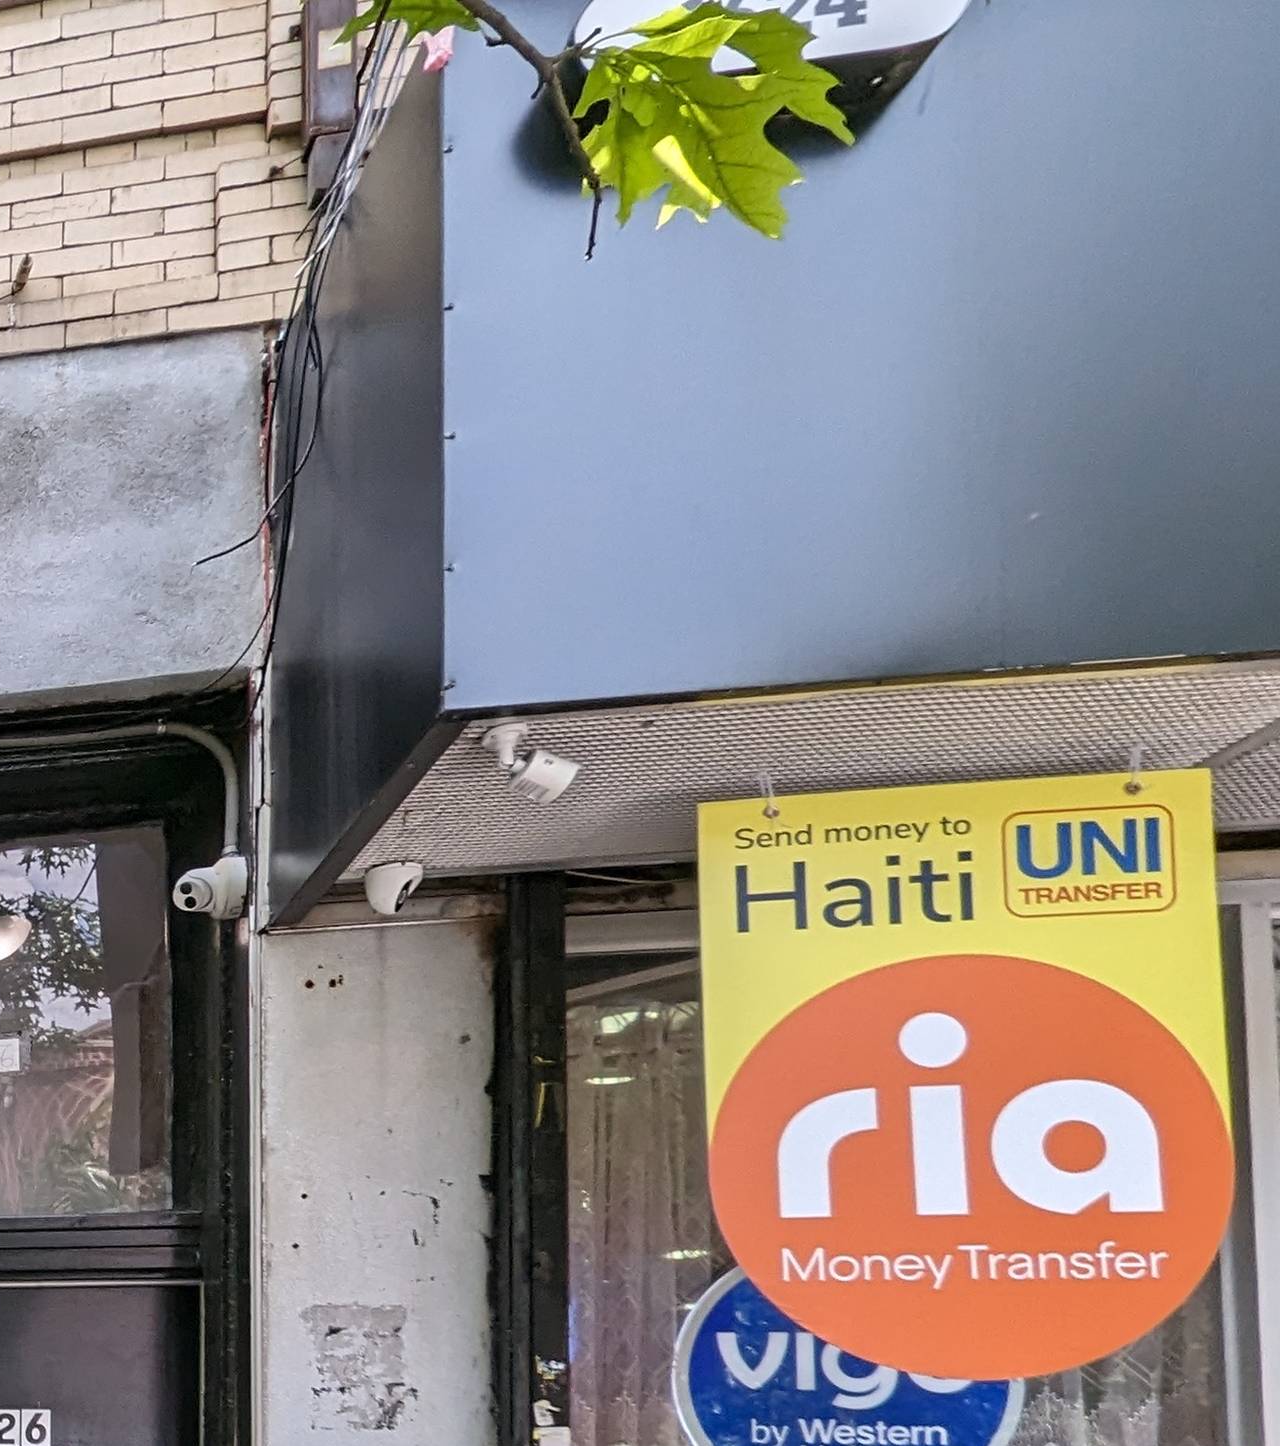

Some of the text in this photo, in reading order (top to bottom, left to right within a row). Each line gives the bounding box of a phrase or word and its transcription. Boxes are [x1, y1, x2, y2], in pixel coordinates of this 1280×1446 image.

[734, 816, 972, 850] Send money to
[1016, 817, 1162, 879] UNI
[735, 850, 975, 934] Haiti
[1019, 881, 1163, 905] TRANSFER
[776, 1011, 1164, 1218] ria
[780, 1241, 1170, 1288] Money Transfer
[798, 1418, 949, 1446] Western
